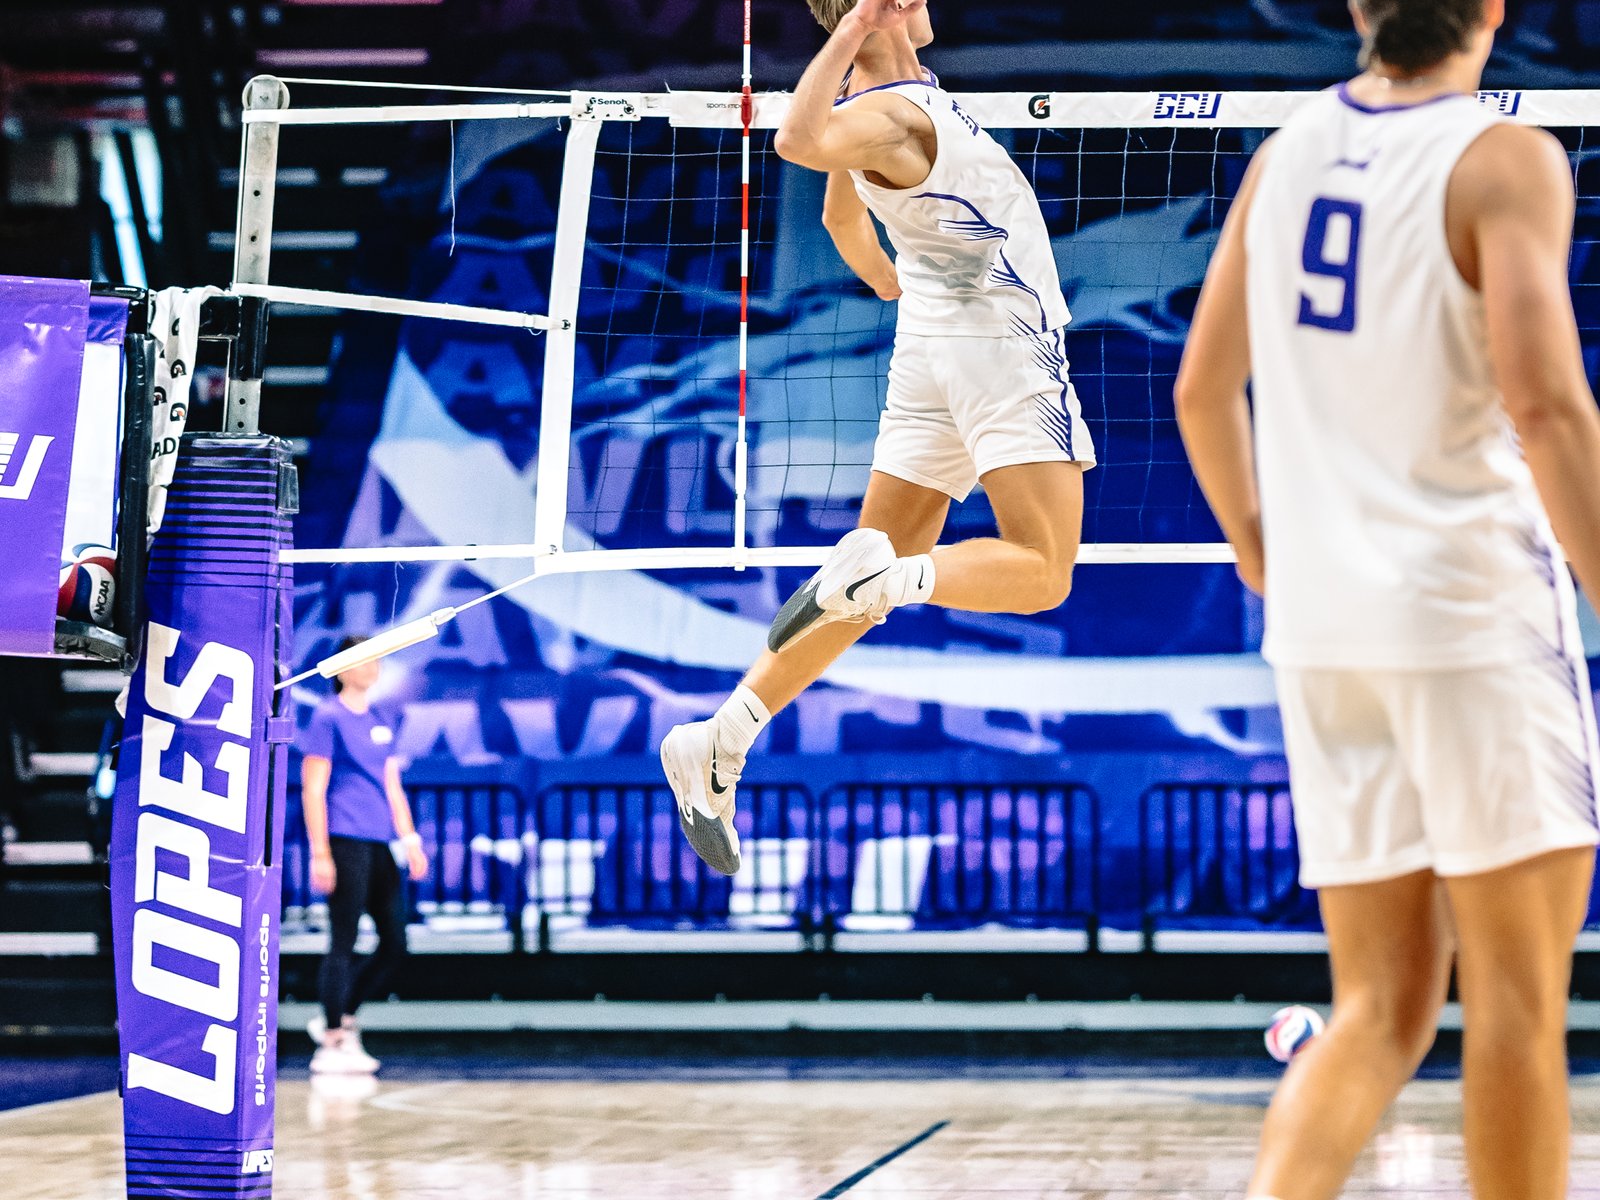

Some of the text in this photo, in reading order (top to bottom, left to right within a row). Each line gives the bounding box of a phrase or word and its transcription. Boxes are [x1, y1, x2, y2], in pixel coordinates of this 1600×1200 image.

[1028, 94, 1050, 119] G
[1153, 93, 1223, 119] GCU
[1298, 197, 1362, 332] 9
[94, 580, 110, 615] NCAA
[127, 621, 255, 1116] LOPES
[255, 913, 271, 1106] sports imports
